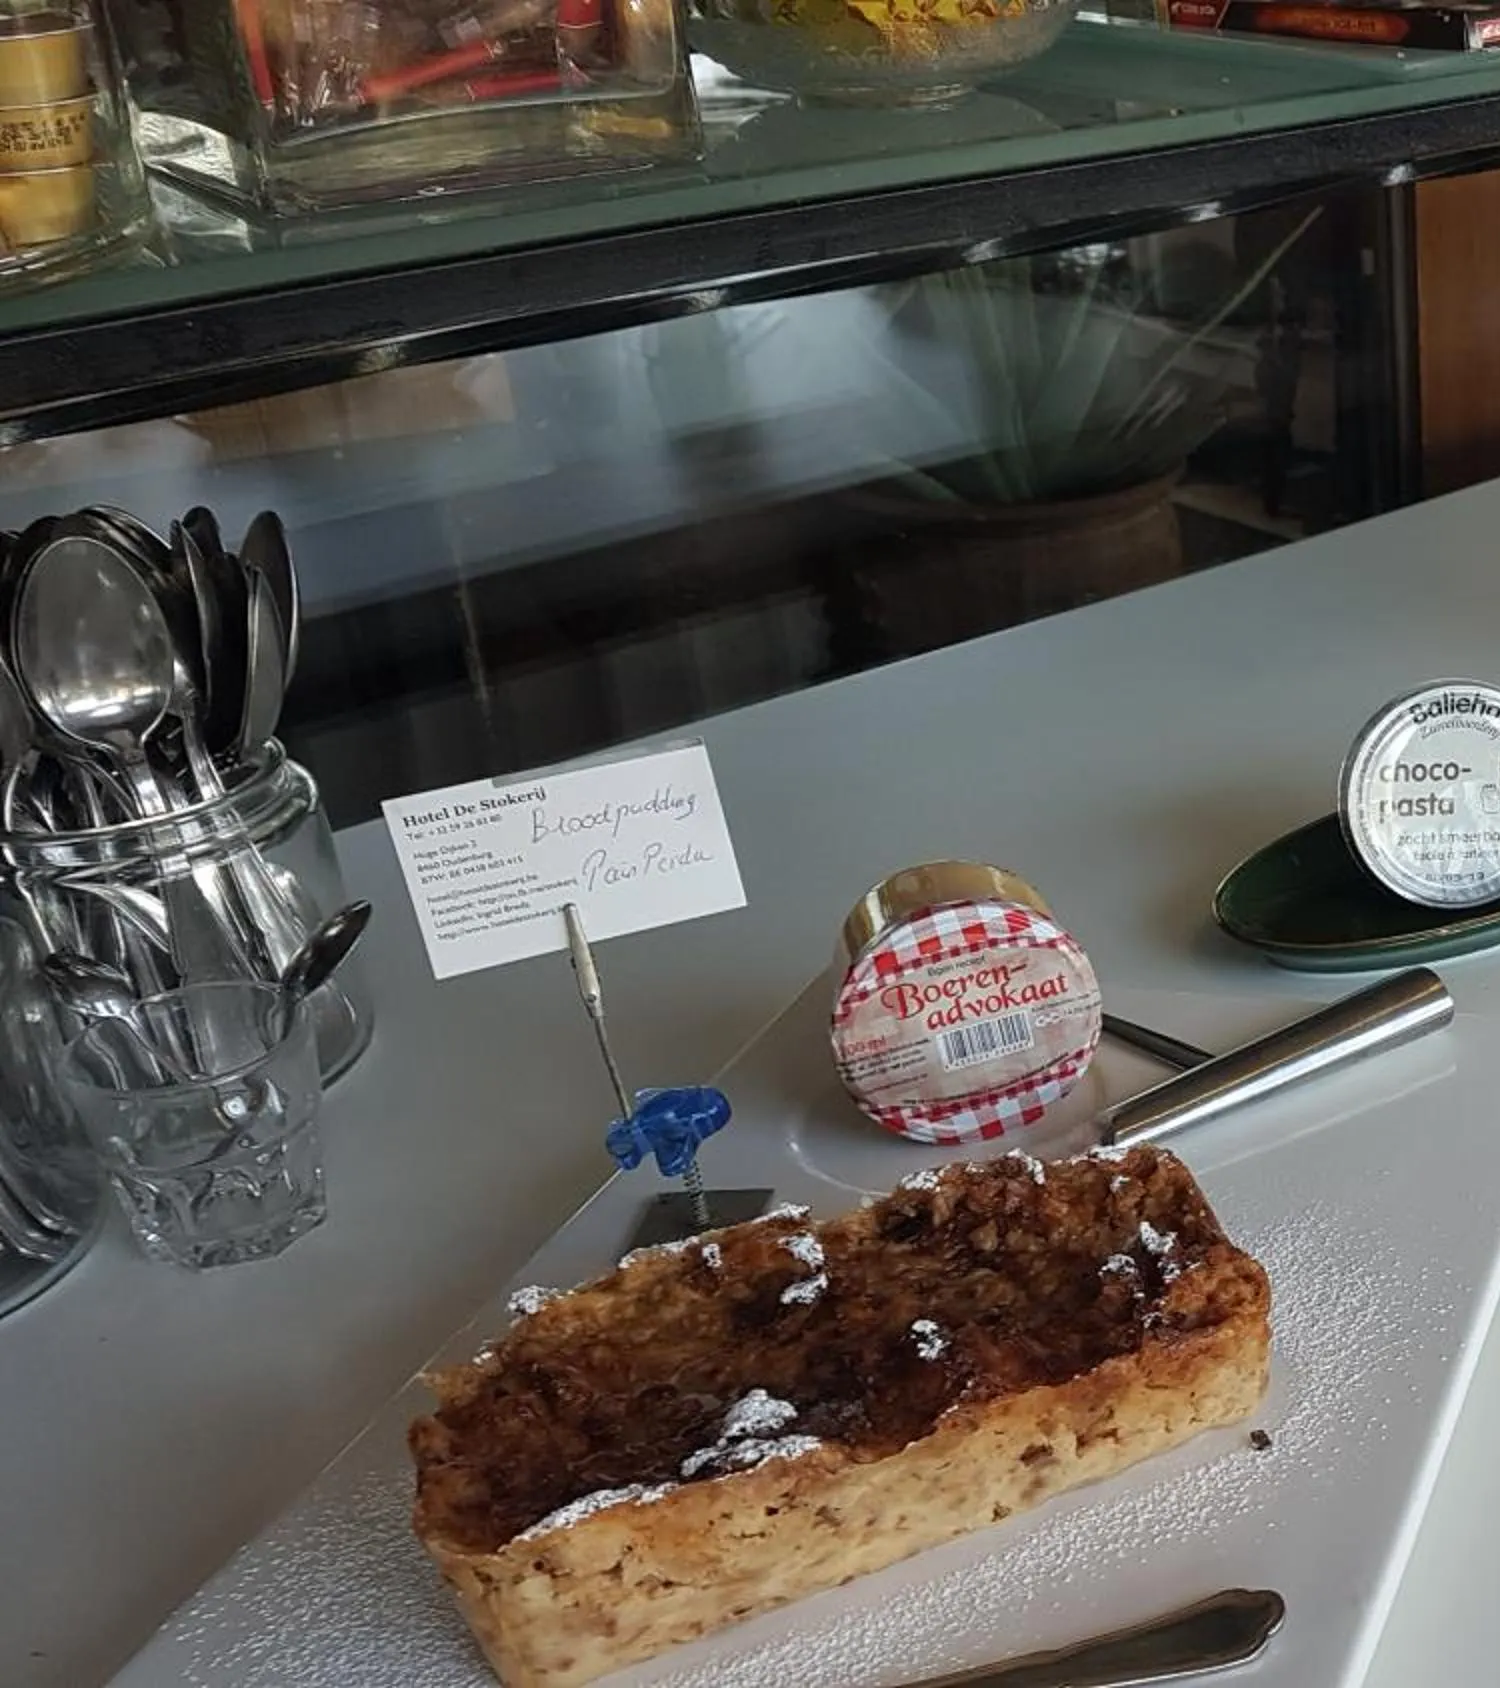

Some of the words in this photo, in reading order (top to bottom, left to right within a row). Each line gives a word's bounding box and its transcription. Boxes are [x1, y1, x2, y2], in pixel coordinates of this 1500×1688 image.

[1379, 761, 1473, 784] choco-
[403, 807, 450, 828] Hotel
[453, 804, 476, 817] De
[480, 786, 547, 811] Stokerij
[1378, 791, 1455, 823] pasta
[881, 963, 1027, 1020] Boeren-
[927, 973, 1068, 1031] advokaat
